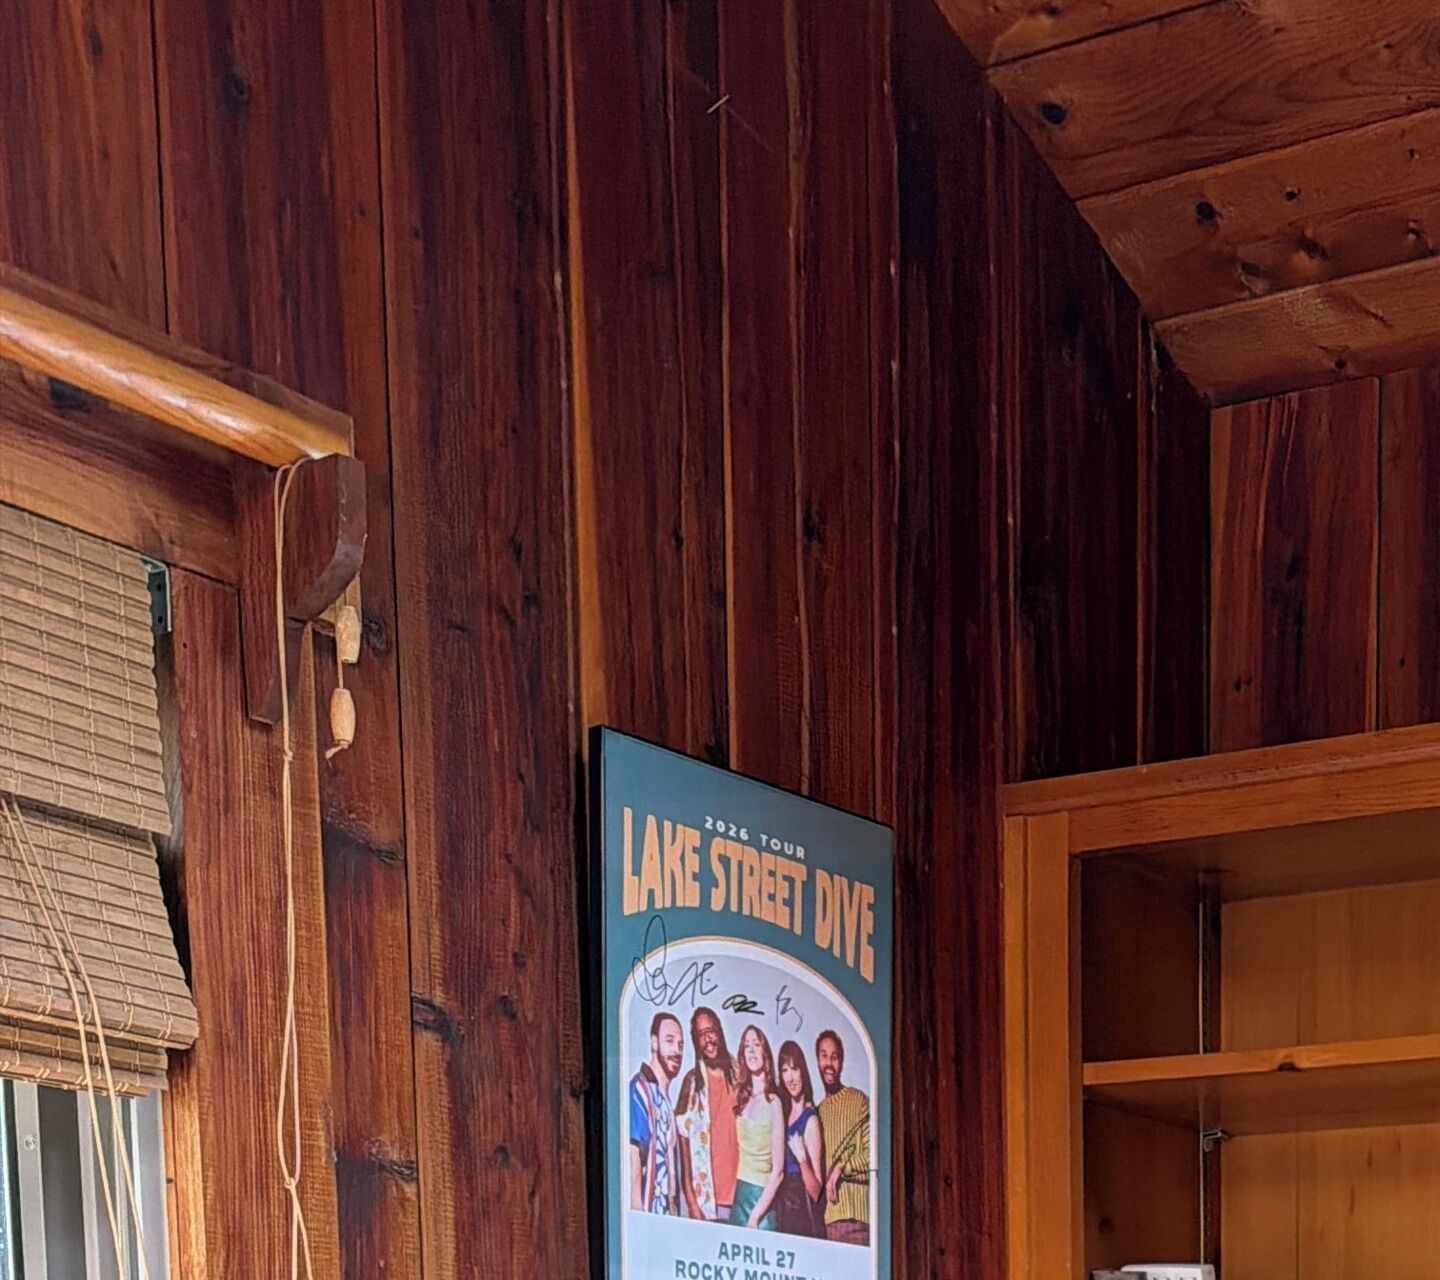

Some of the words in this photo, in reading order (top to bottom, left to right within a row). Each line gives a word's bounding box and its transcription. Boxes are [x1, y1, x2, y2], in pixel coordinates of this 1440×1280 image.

[704, 815, 750, 841] 2026
[759, 833, 806, 860] TOUR
[622, 806, 701, 916] LAKE
[709, 836, 808, 936] STREET
[814, 868, 875, 984] DIVE
[717, 1241, 771, 1267] APRIL
[775, 1250, 796, 1270] 27
